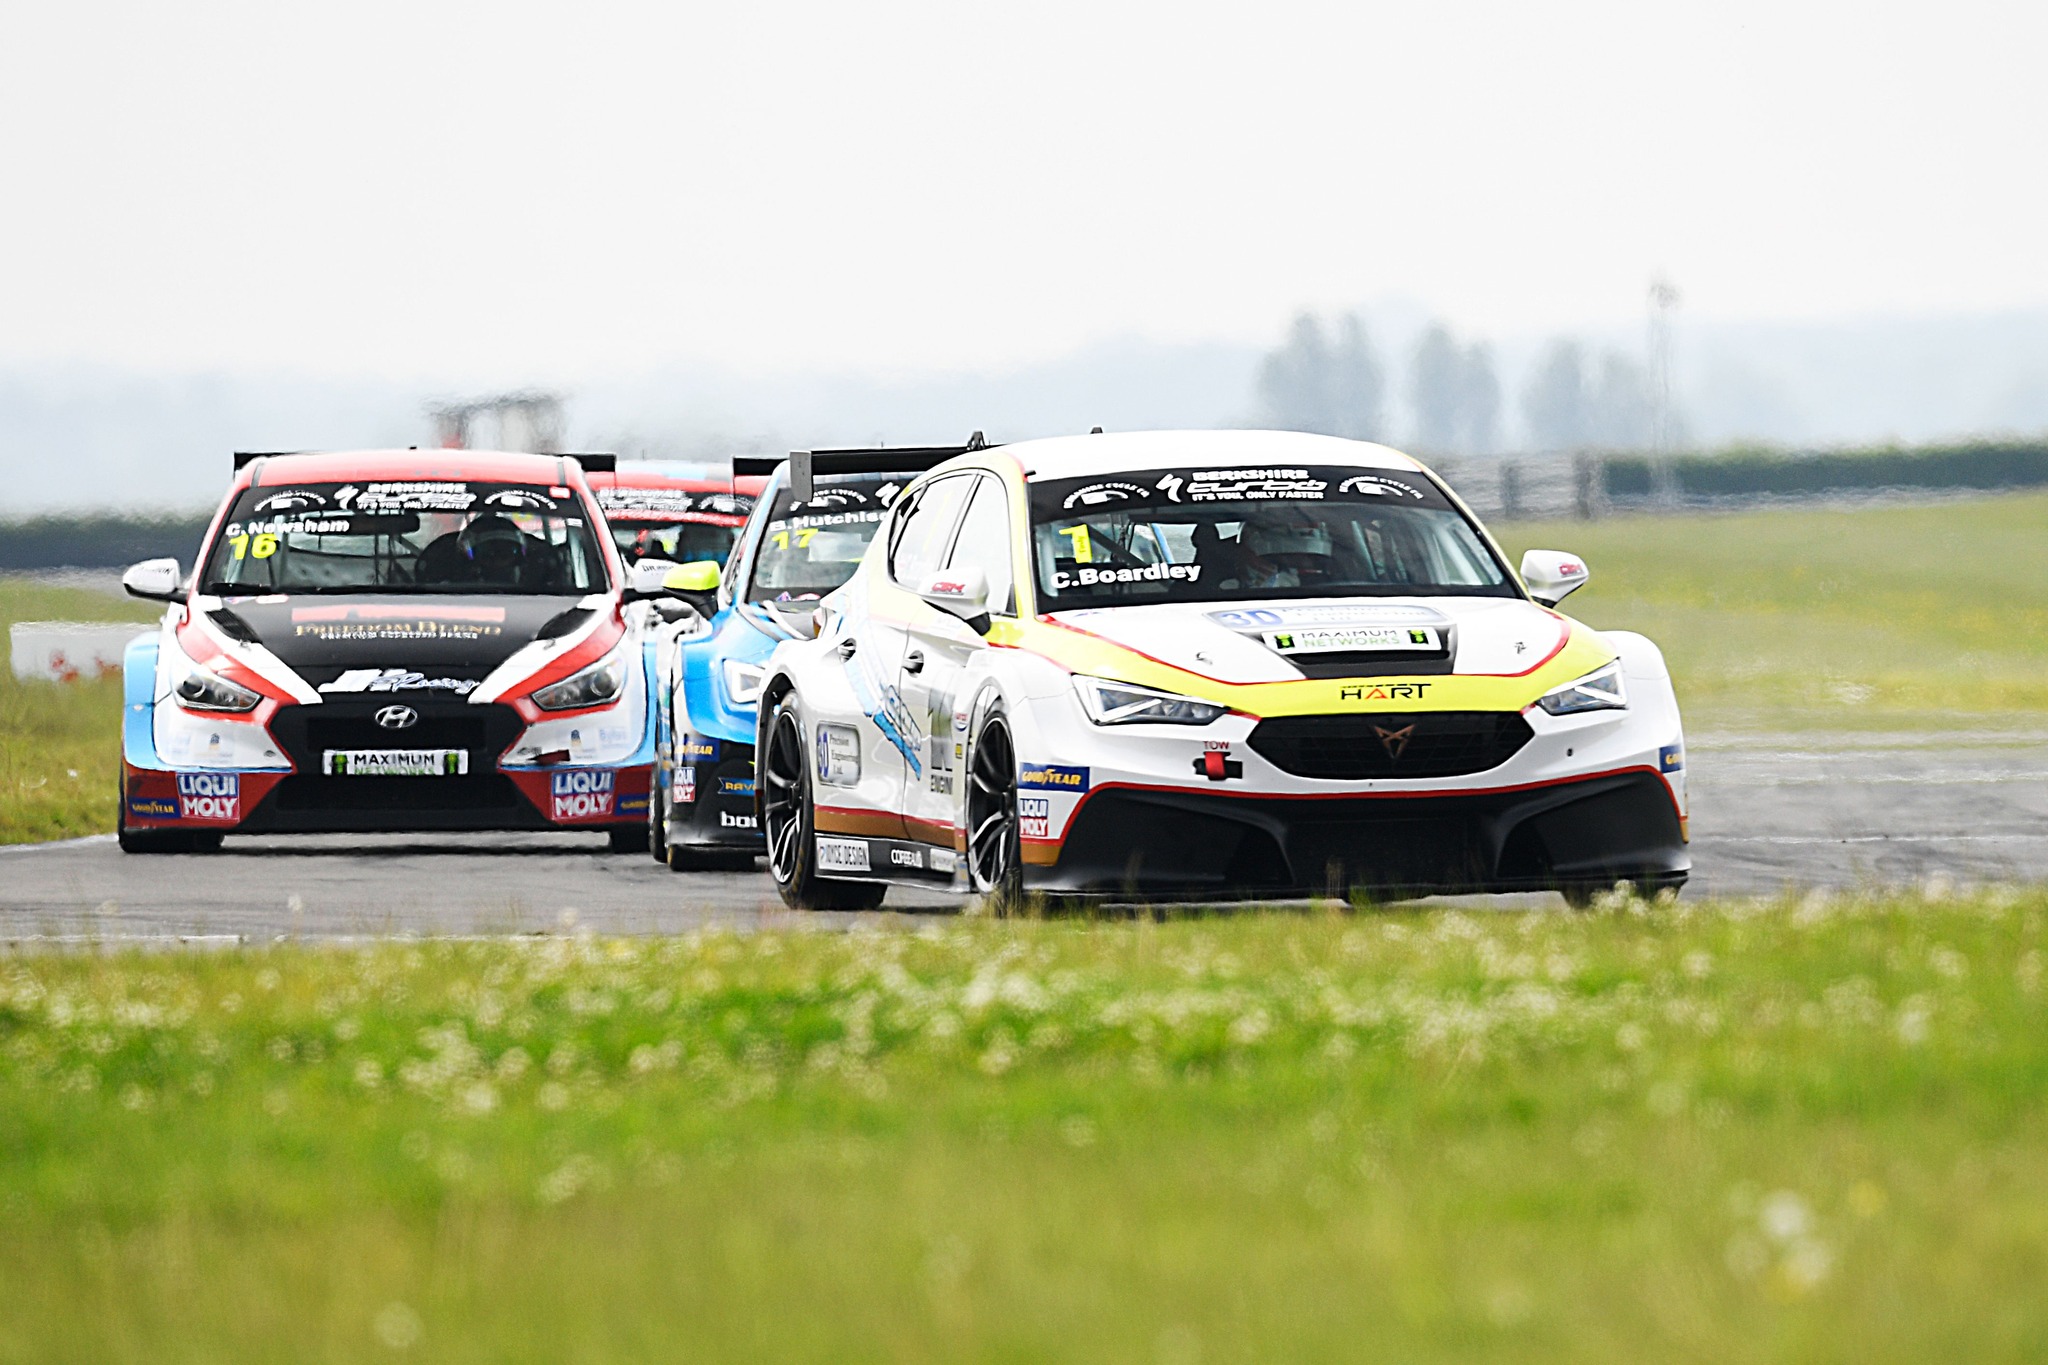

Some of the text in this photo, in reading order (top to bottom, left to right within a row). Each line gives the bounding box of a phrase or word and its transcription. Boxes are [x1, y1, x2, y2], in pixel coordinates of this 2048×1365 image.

[1192, 469, 1309, 481] BERKSHIRE
[1186, 479, 1328, 493] turbo
[1246, 491, 1276, 499] ONLY
[1278, 491, 1324, 499] FASTER
[229, 533, 278, 560] 16
[772, 528, 818, 550] 17
[1059, 524, 1093, 564] 1
[1051, 562, 1201, 589] C.Boardley
[1222, 610, 1283, 626] 3D
[1301, 629, 1398, 639] MAXIMUM
[1303, 636, 1400, 648] NETWORKS
[1341, 683, 1432, 700] HART
[1203, 740, 1230, 750] TOW
[354, 753, 435, 766] MAXIMUM
[180, 774, 236, 796] LIQUI
[555, 771, 612, 794] LIQUI
[1022, 768, 1082, 785] GOODYEAR
[131, 801, 175, 815] GOODYEAR
[182, 796, 238, 817] MOLY
[555, 793, 613, 817] MOLY
[1020, 799, 1047, 817] LIQUI
[1020, 817, 1047, 836] MOLY
